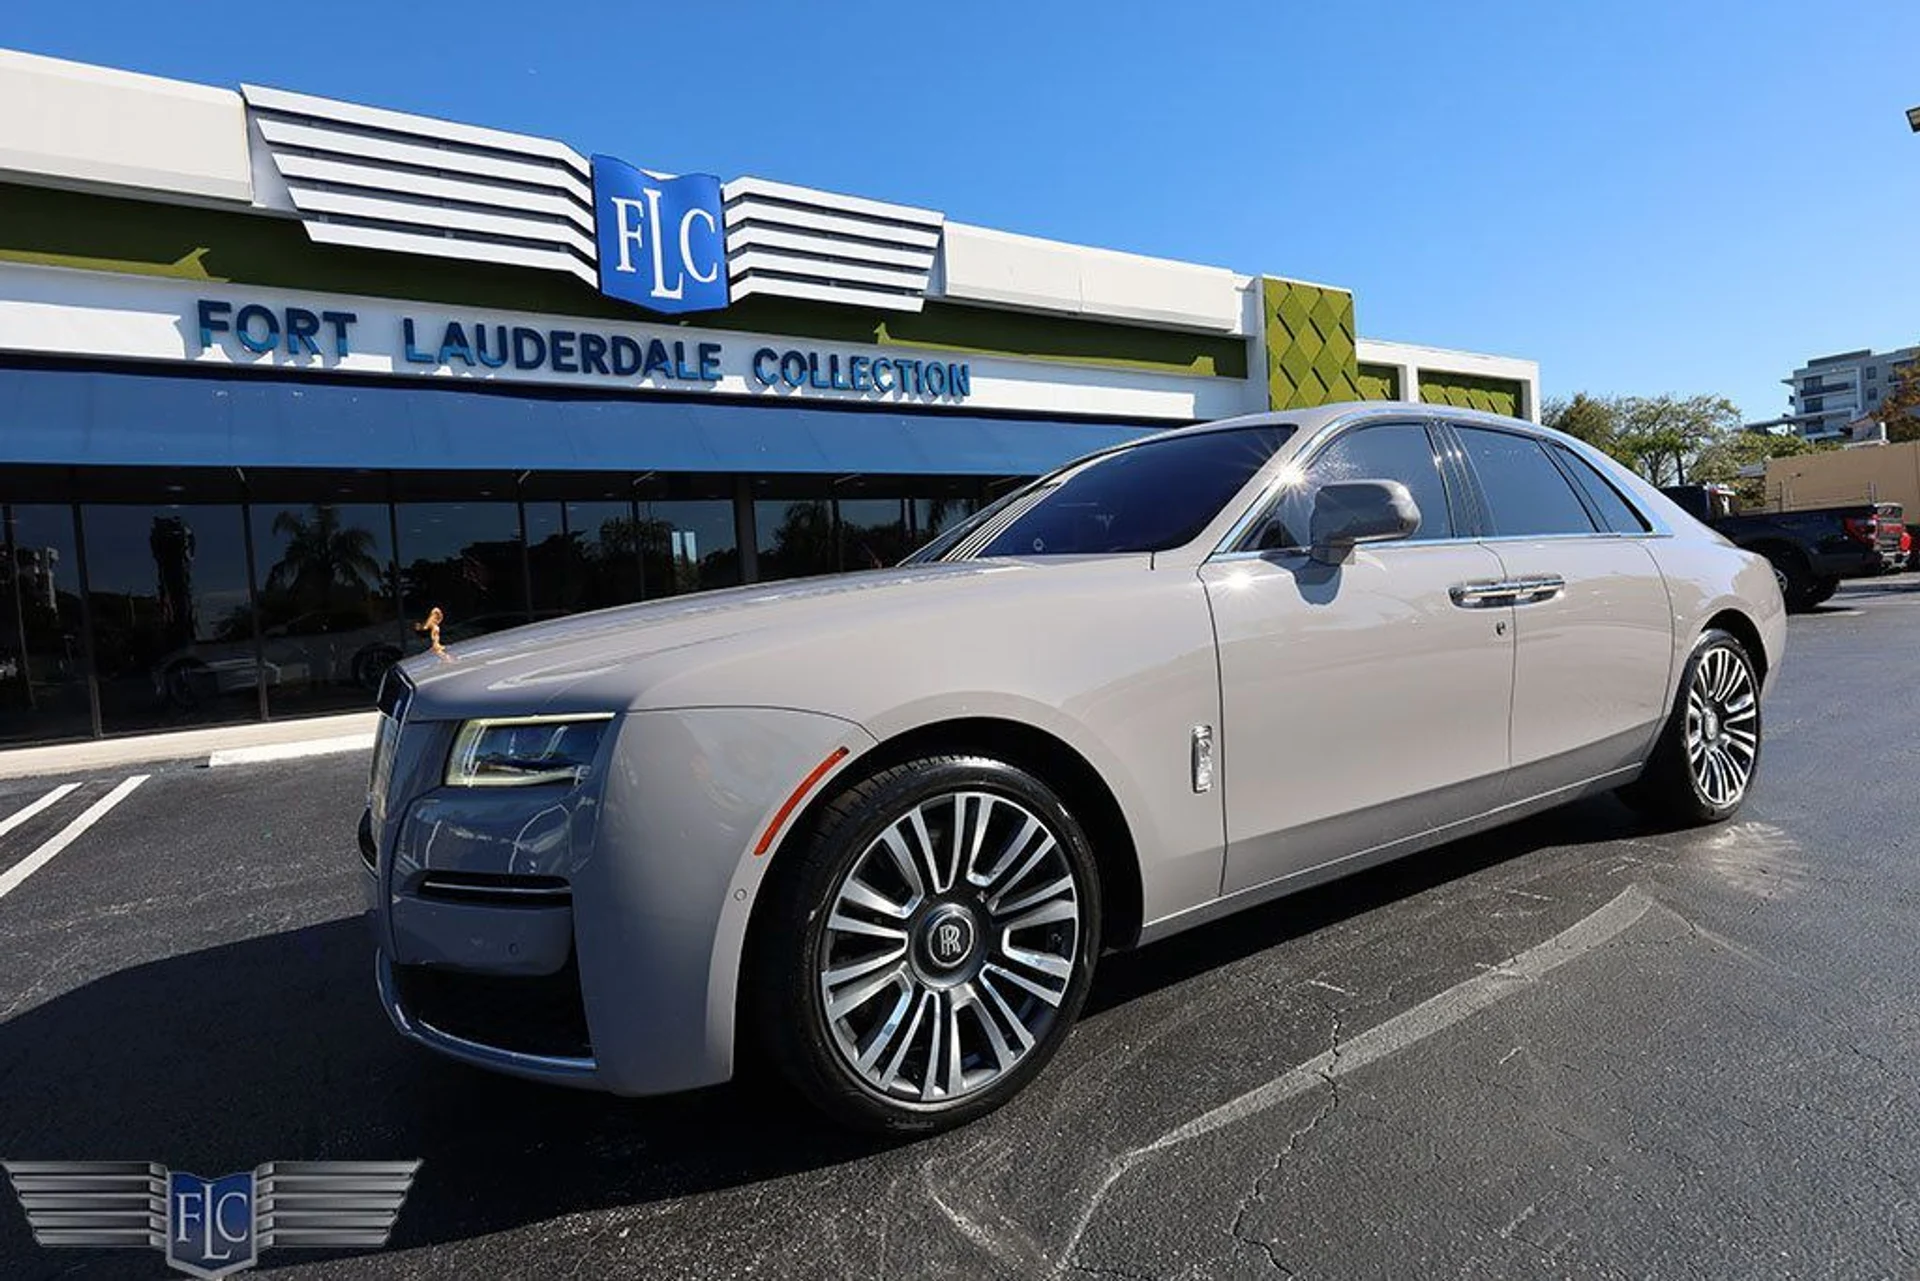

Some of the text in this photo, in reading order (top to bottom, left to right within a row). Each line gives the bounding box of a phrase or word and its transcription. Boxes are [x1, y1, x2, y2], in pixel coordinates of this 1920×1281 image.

[611, 187, 718, 299] FLC
[197, 300, 972, 397] FORT LAUDERDALE COLLECTION
